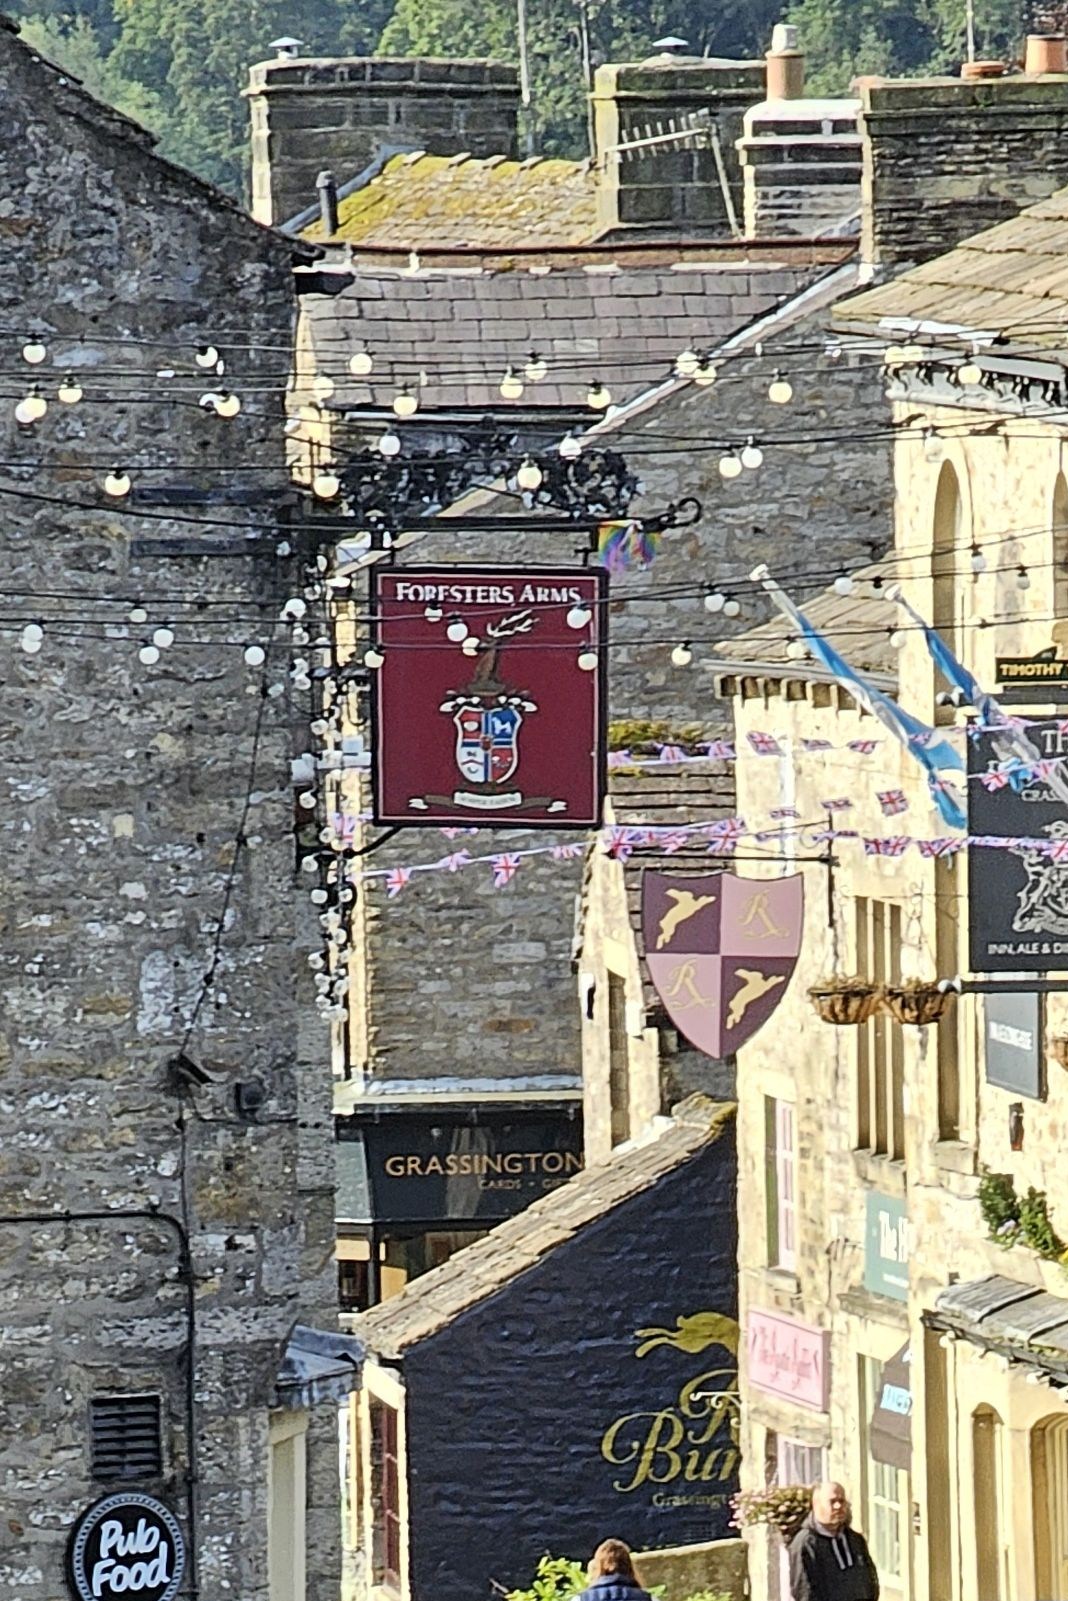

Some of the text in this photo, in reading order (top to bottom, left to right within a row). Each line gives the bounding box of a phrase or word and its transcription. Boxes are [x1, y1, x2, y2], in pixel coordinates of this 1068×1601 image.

[396, 583, 581, 603] FORESTERS ARMS
[1000, 663, 1063, 677] TIMOTHY
[1016, 942, 1039, 954] ALE
[1041, 942, 1051, 954] &
[385, 1152, 585, 1176] GRASSINGTON
[100, 1517, 160, 1559] Pub
[92, 1541, 171, 1597] Food
